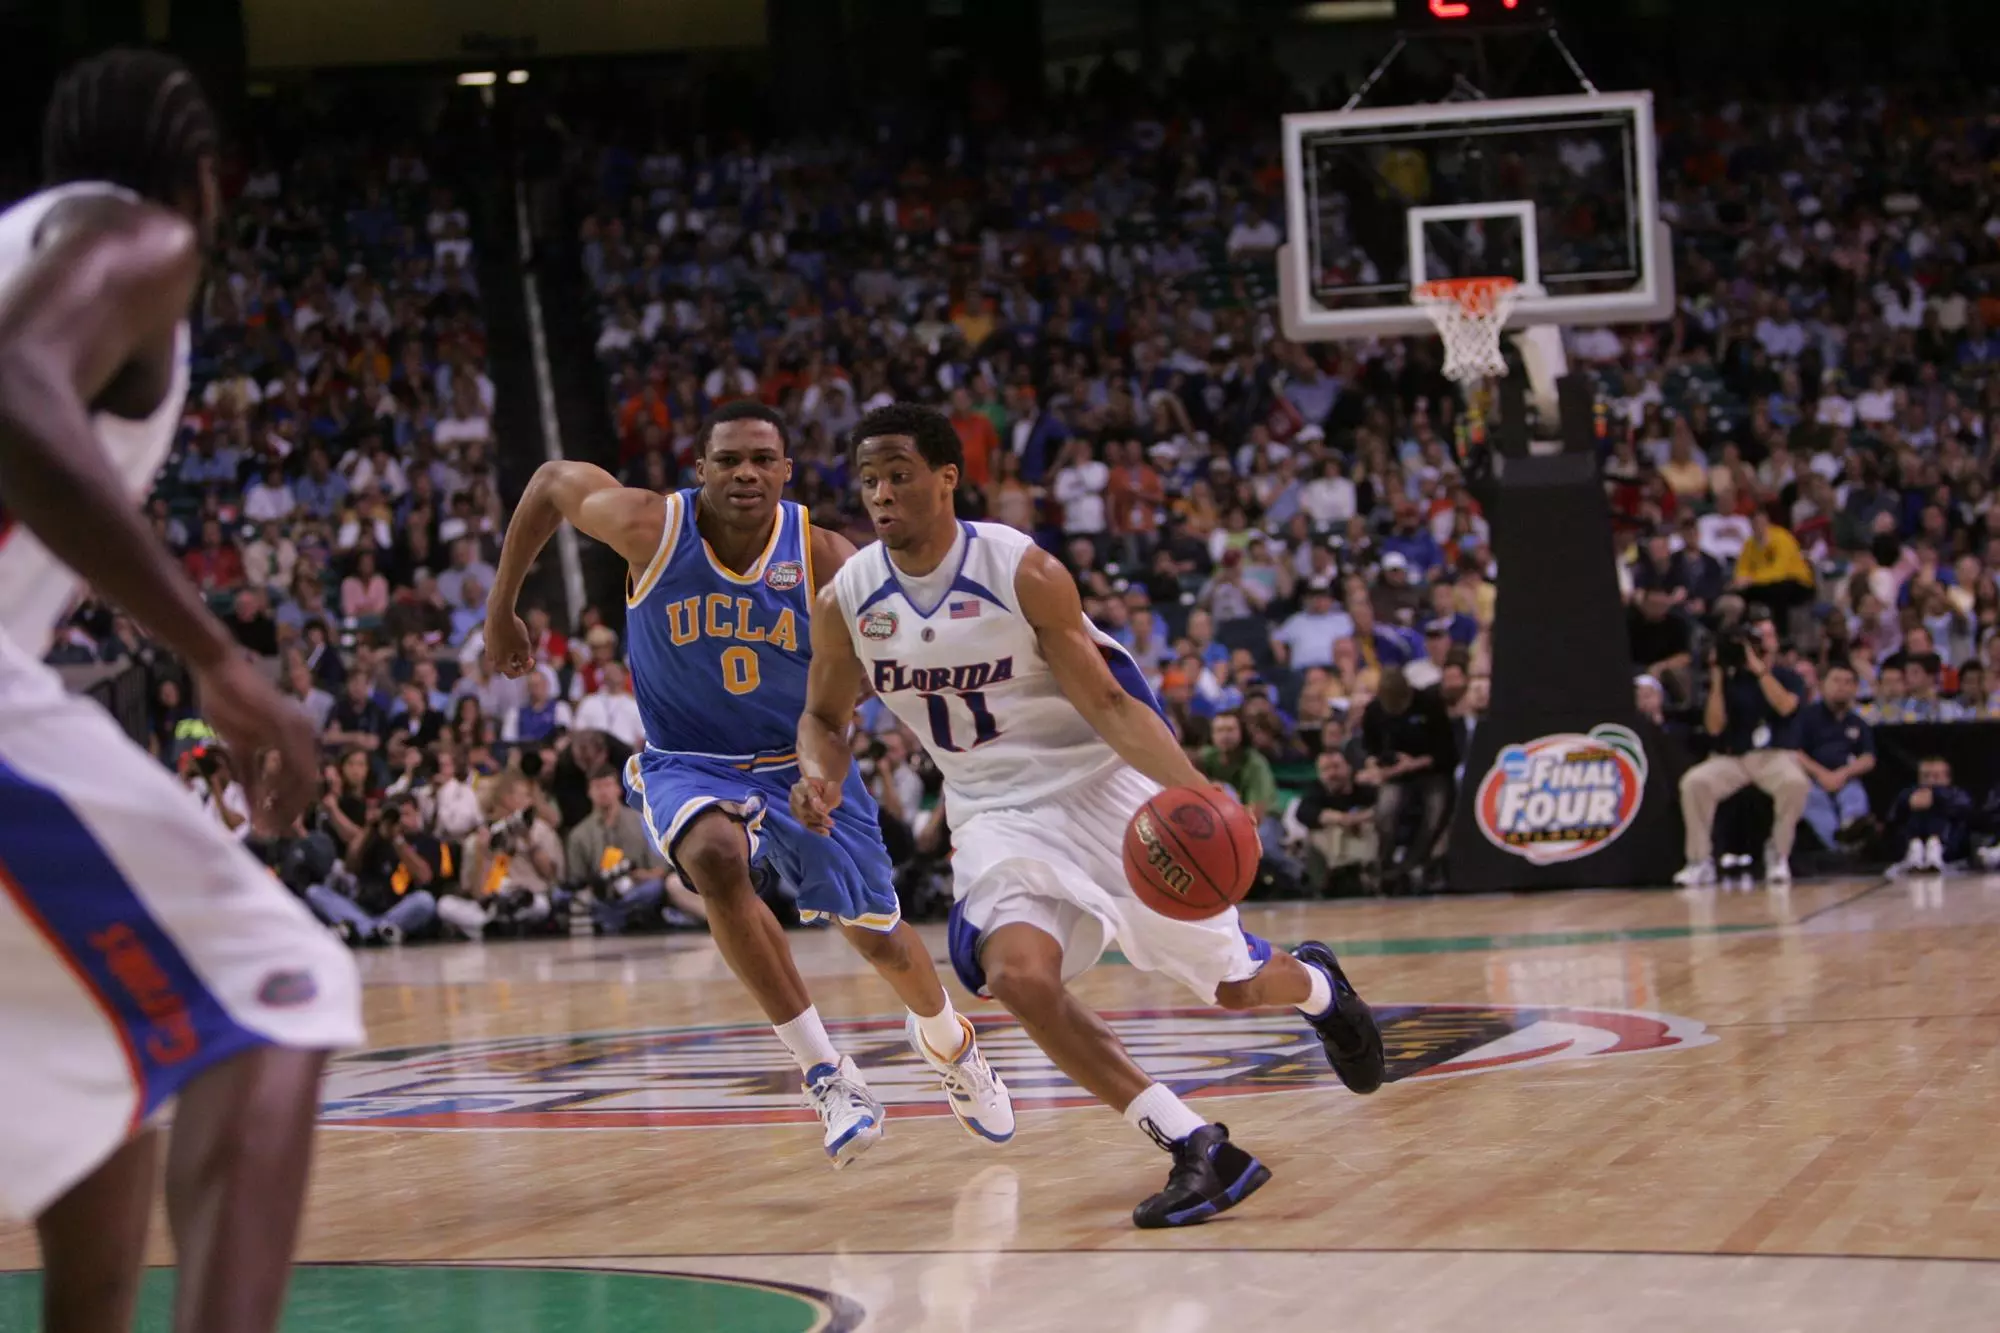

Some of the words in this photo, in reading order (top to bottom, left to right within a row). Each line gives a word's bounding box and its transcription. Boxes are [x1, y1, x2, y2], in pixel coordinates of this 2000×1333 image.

[666, 593, 798, 651] UCLA
[721, 646, 761, 695] 0
[872, 655, 1014, 693] FLORIDA
[916, 691, 1007, 753] 11
[1533, 759, 1615, 788] FINAL
[1497, 783, 1617, 829] FOUR
